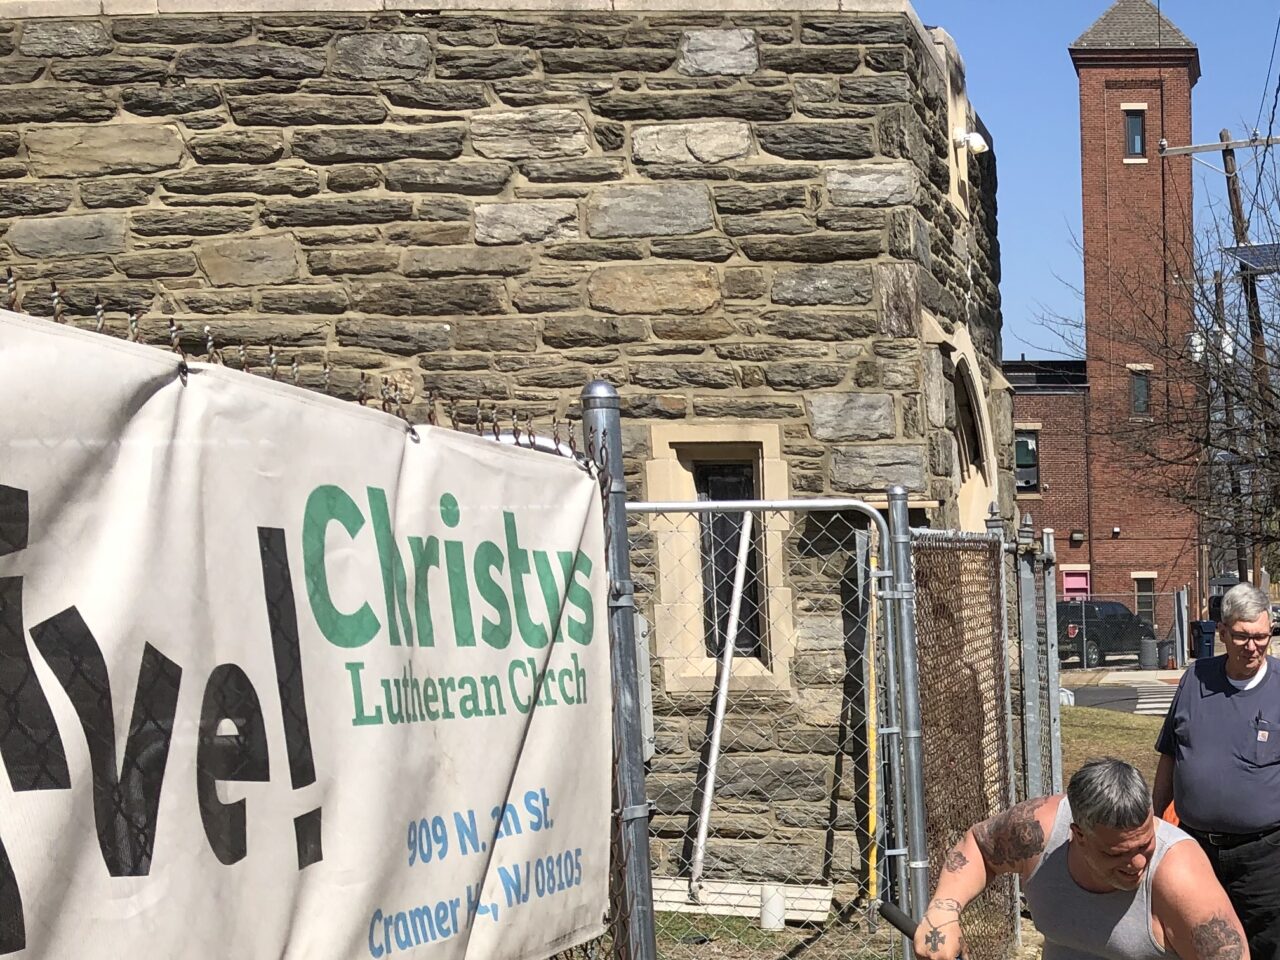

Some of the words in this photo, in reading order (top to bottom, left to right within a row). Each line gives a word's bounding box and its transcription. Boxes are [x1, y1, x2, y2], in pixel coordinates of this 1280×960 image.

[345, 659, 507, 727] Lutheran
[508, 652, 588, 714] Chrch
[407, 815, 448, 867] 909
[453, 809, 487, 856] N.
[524, 787, 554, 832] St.
[368, 897, 461, 959] Cramer
[497, 861, 531, 907] NJ
[535, 848, 583, 898] 08105
